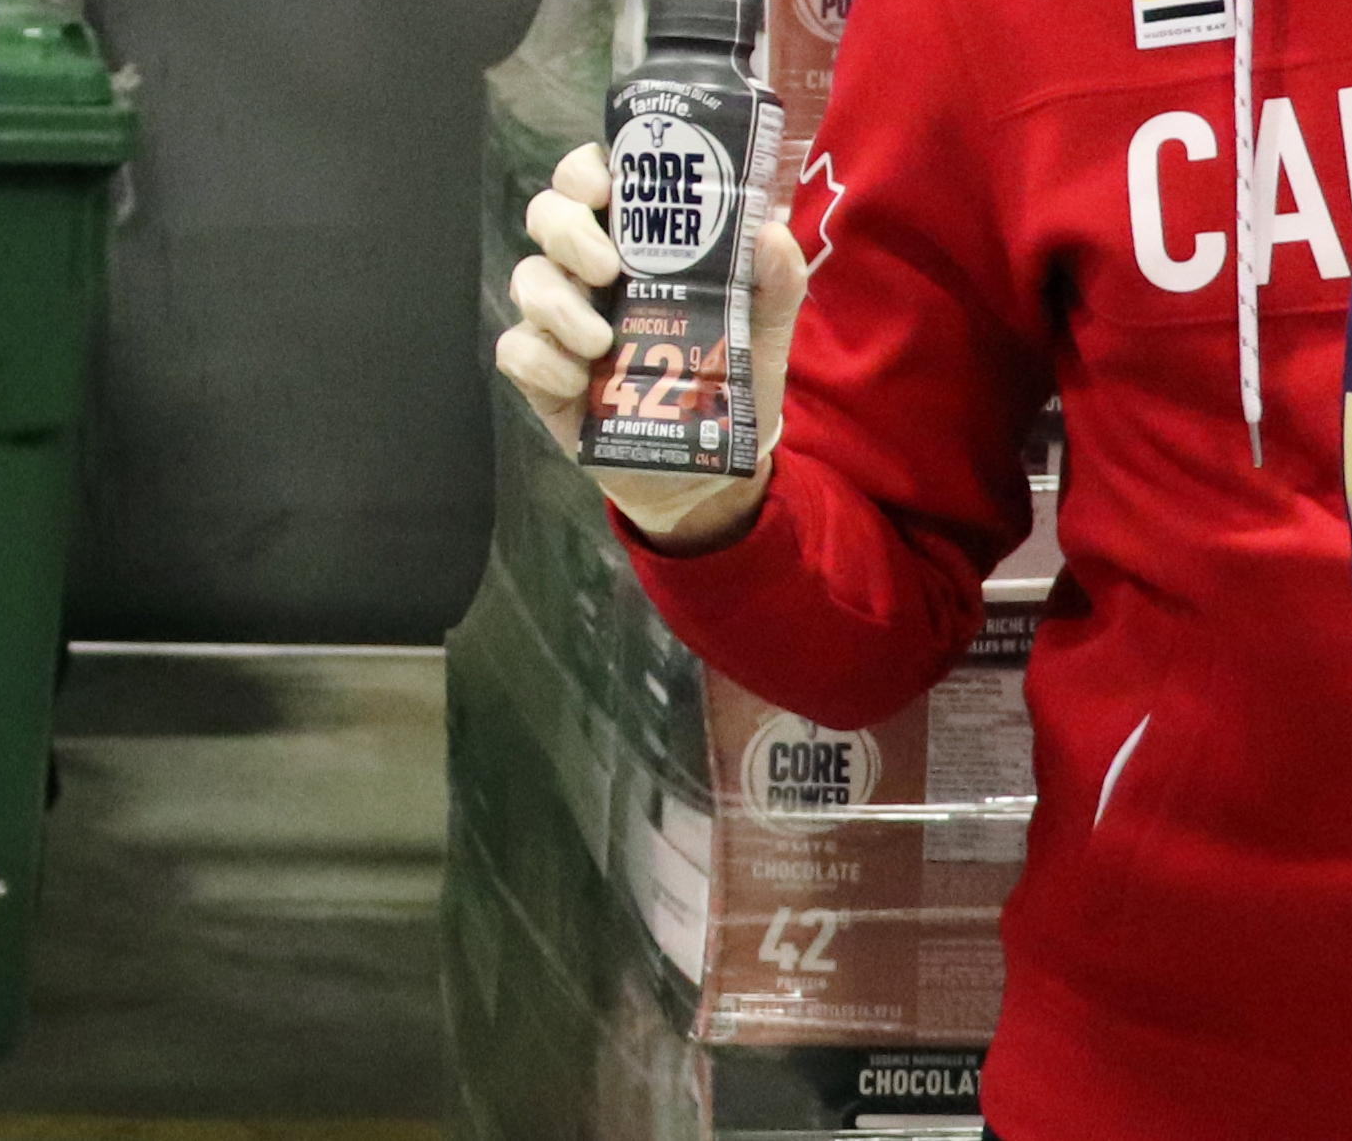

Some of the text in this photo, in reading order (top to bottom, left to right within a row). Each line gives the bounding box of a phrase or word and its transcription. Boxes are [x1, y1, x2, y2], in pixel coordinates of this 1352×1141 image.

[1144, 23, 1226, 39] HUDSON'S BAY
[629, 93, 690, 117] fairlife
[702, 93, 724, 110] LAIT
[620, 152, 705, 205] CORE
[620, 207, 702, 246] POWER
[626, 280, 687, 301] ÉLITE
[621, 317, 689, 336] CHOCOLAT
[601, 419, 686, 438] DE PROTÉINES
[986, 618, 1026, 634] RICHE
[767, 741, 853, 784] CORE
[752, 861, 861, 883] CHOCOLATE
